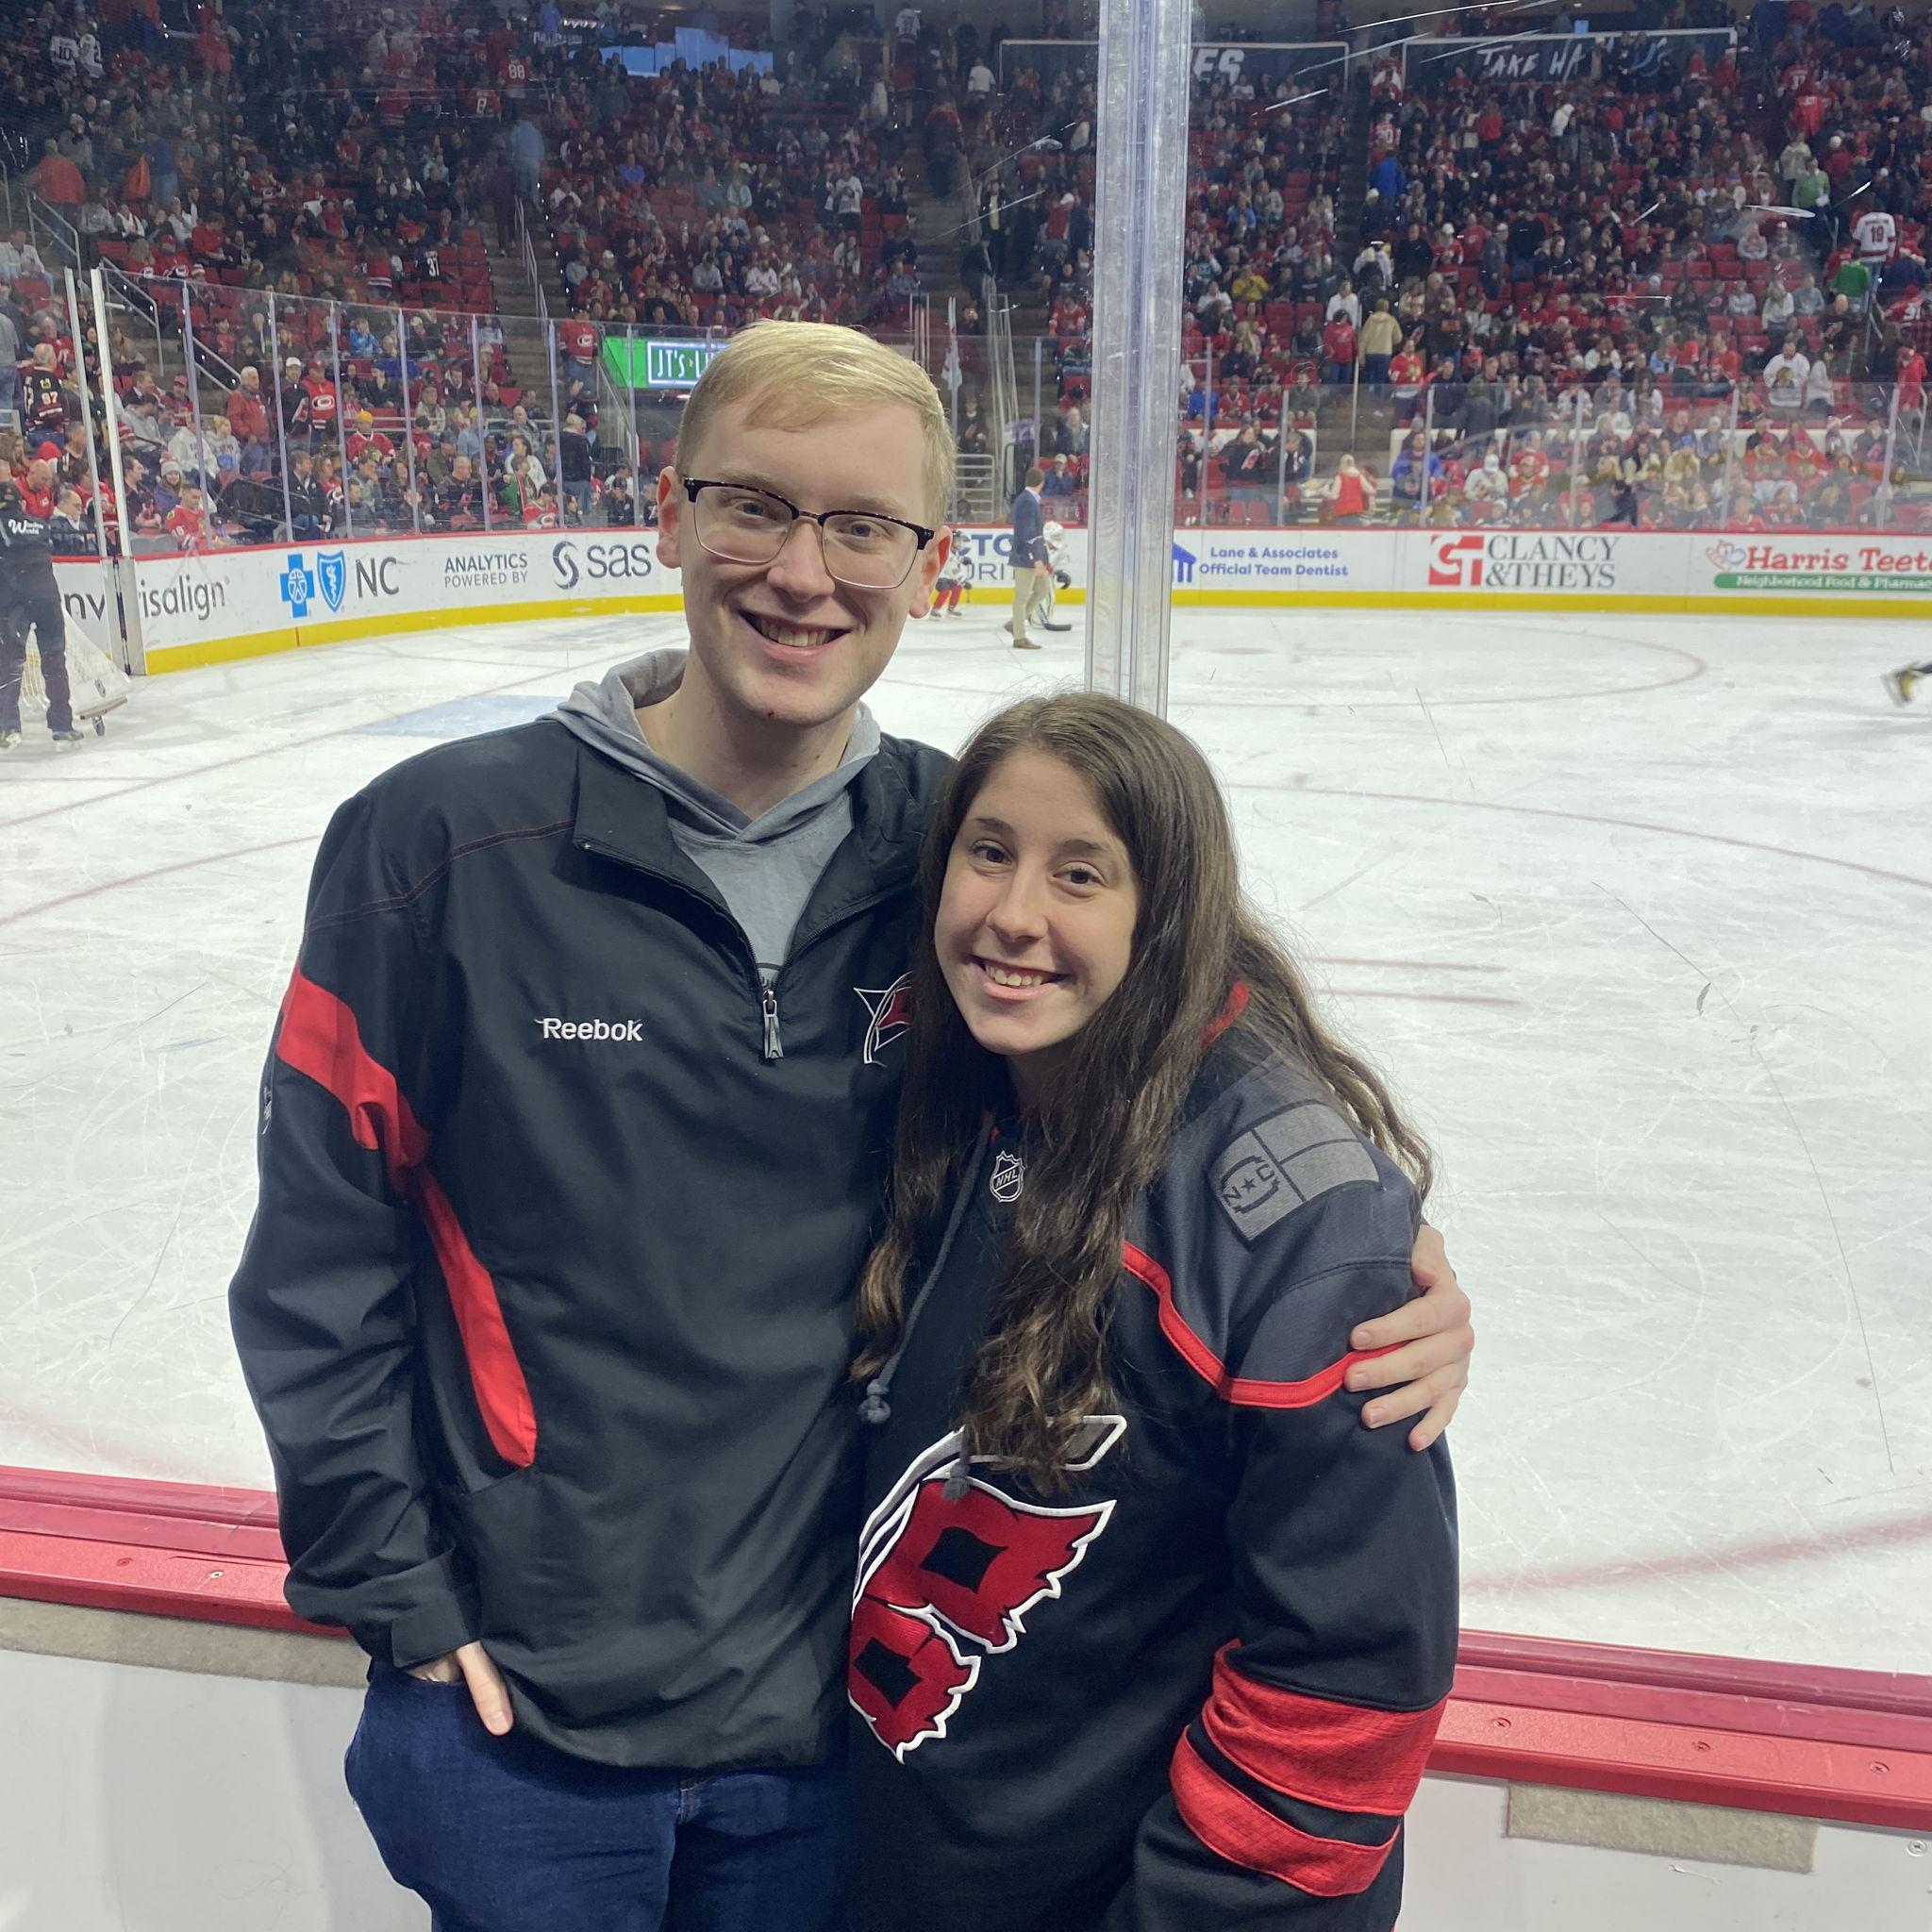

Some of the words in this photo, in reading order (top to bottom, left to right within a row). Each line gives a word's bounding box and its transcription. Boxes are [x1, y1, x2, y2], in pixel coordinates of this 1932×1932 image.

[1476, 44, 1540, 77] TAKE
[1210, 546, 1245, 558] Lane
[1248, 547, 1259, 558] &
[1261, 547, 1339, 559] Associates
[1488, 535, 1621, 561] CLANCY
[1745, 545, 1849, 571] Harris
[444, 553, 528, 574] ANALYTICS
[587, 544, 652, 578] sas
[1199, 563, 1251, 575] Official
[1255, 564, 1291, 575] Team
[1295, 564, 1349, 576] Dentist
[355, 557, 400, 598] NC
[444, 572, 508, 589] POWERED
[512, 571, 528, 584] BY
[1736, 575, 1823, 589] Neighborhood
[140, 575, 226, 621] isalign
[534, 1017, 643, 1041] Reebok
[994, 1169, 1018, 1189] NHL
